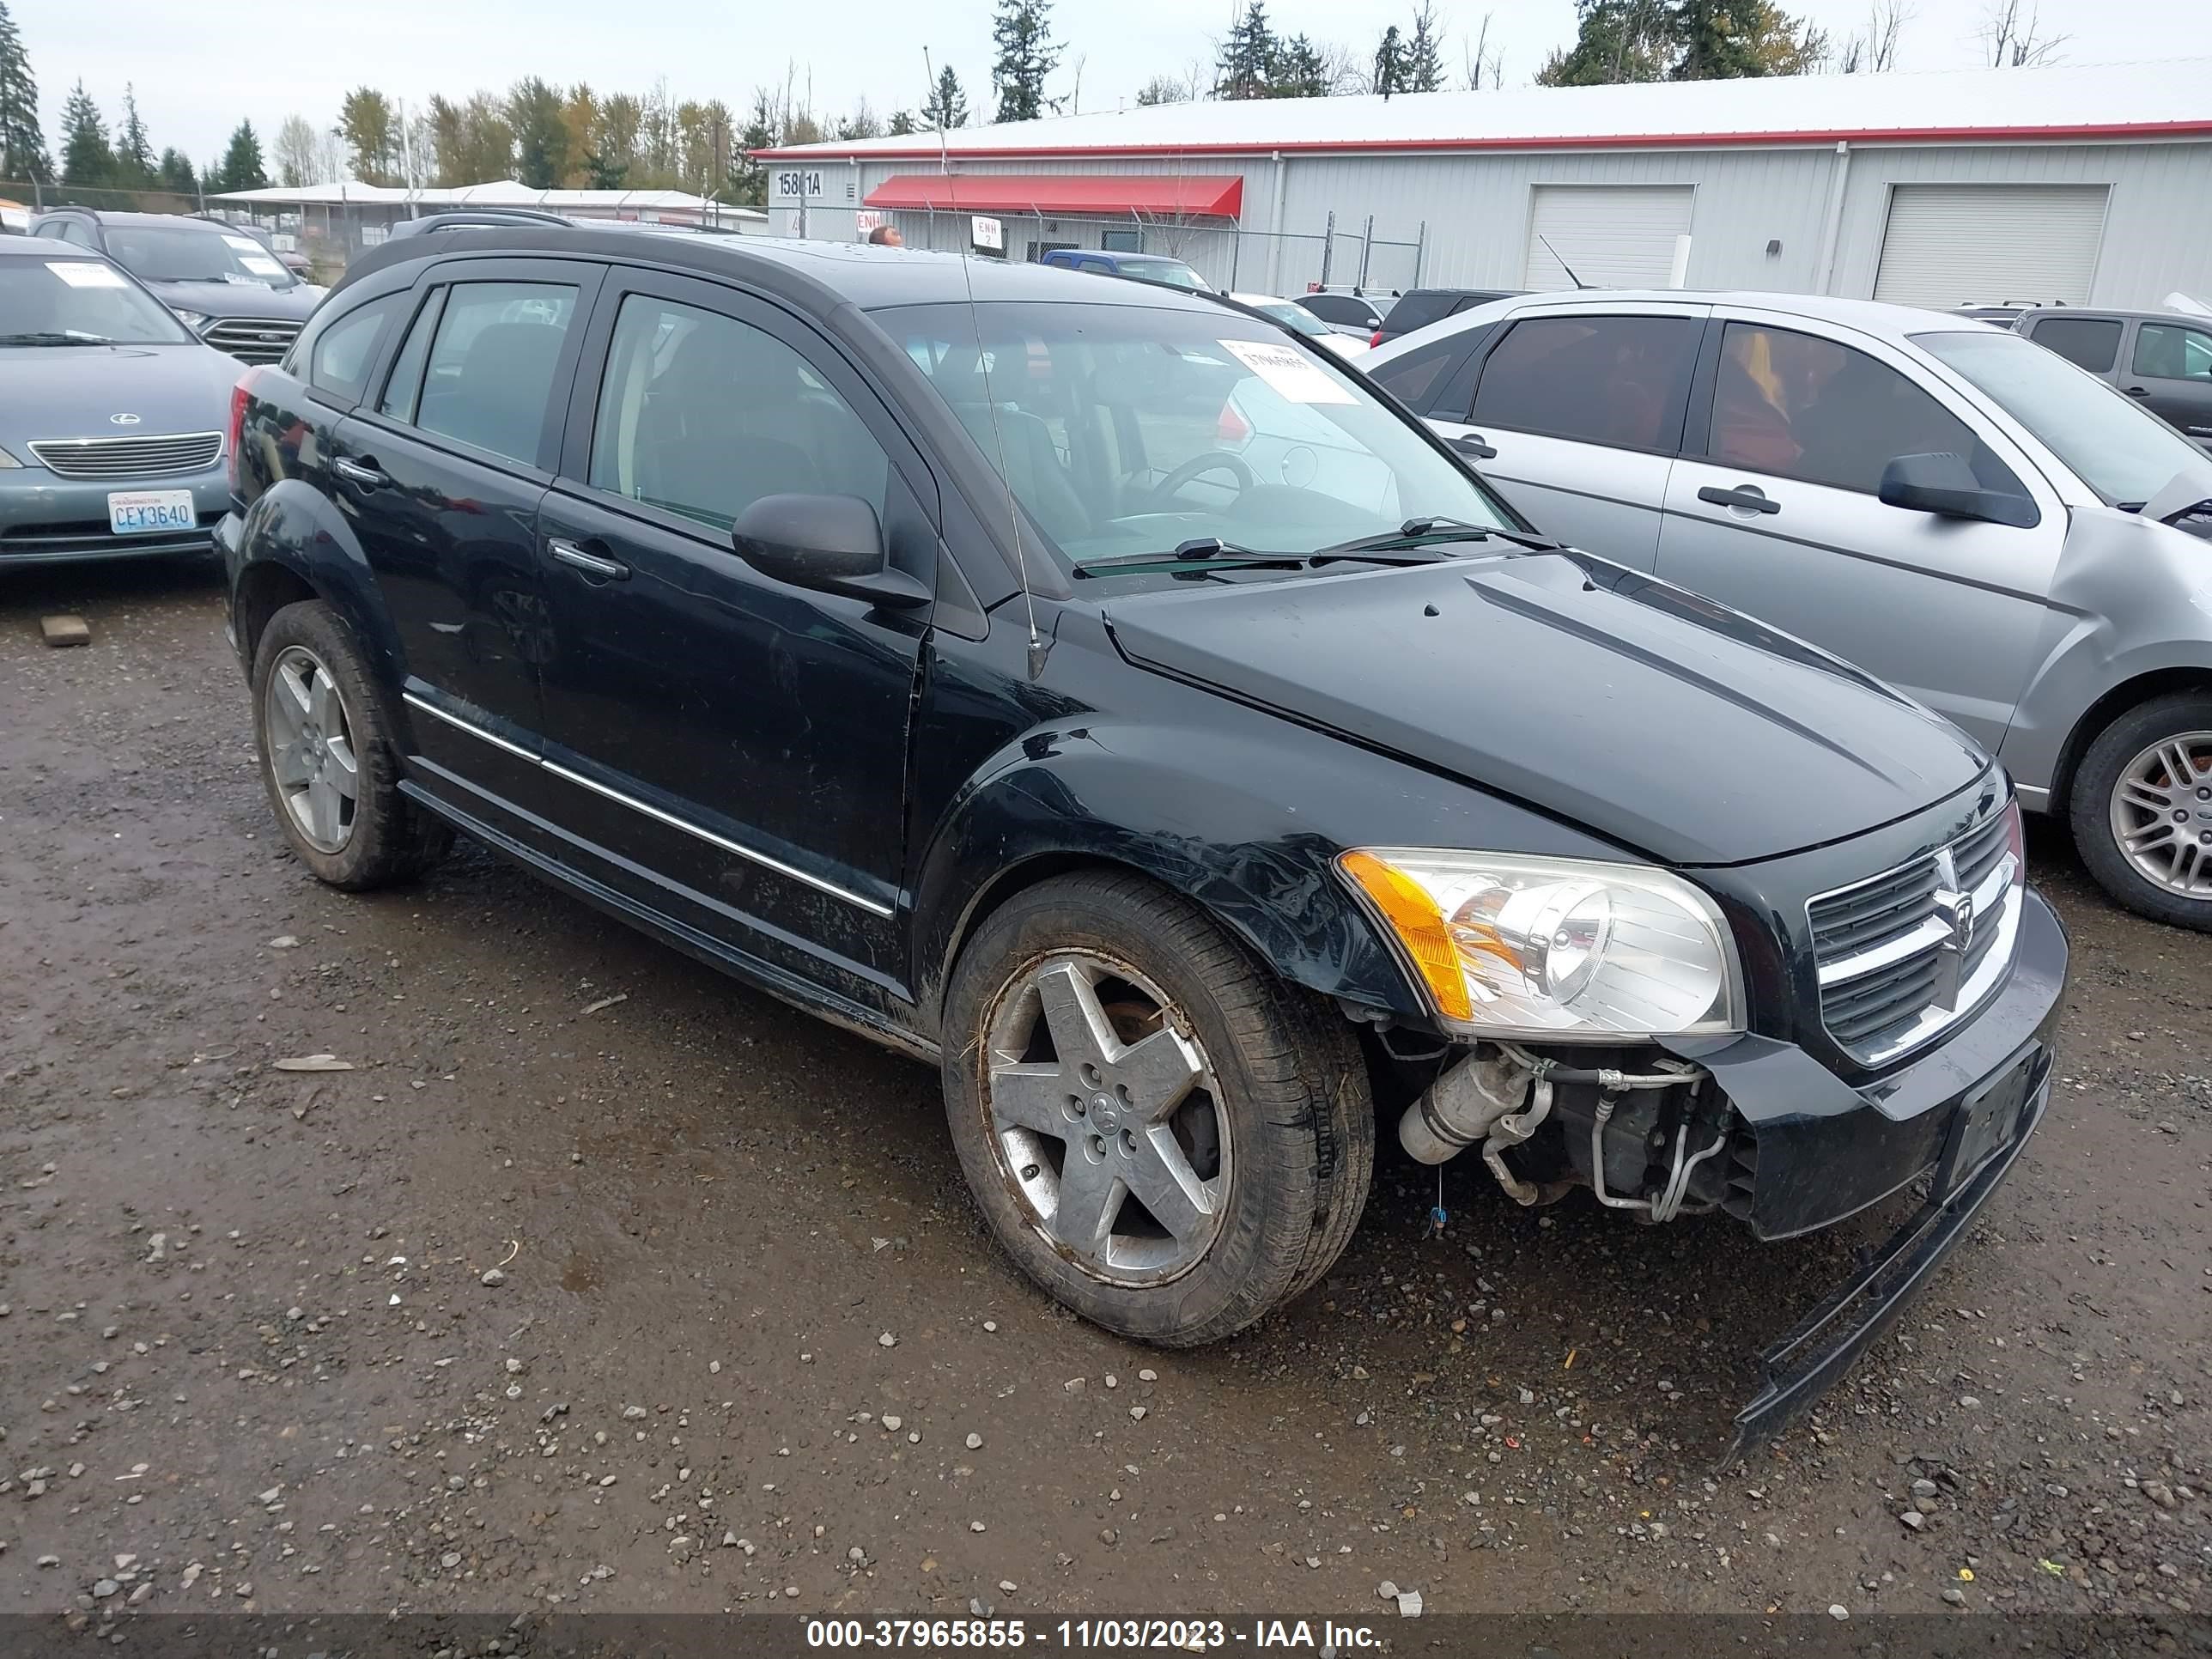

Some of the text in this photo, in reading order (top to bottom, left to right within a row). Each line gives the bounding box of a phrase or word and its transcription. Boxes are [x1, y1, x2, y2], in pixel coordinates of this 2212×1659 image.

[778, 173, 821, 195] 1581A
[858, 215, 880, 228] ENH
[979, 222, 997, 234] ENH
[985, 234, 991, 245] 2
[115, 505, 189, 526] CEY3640
